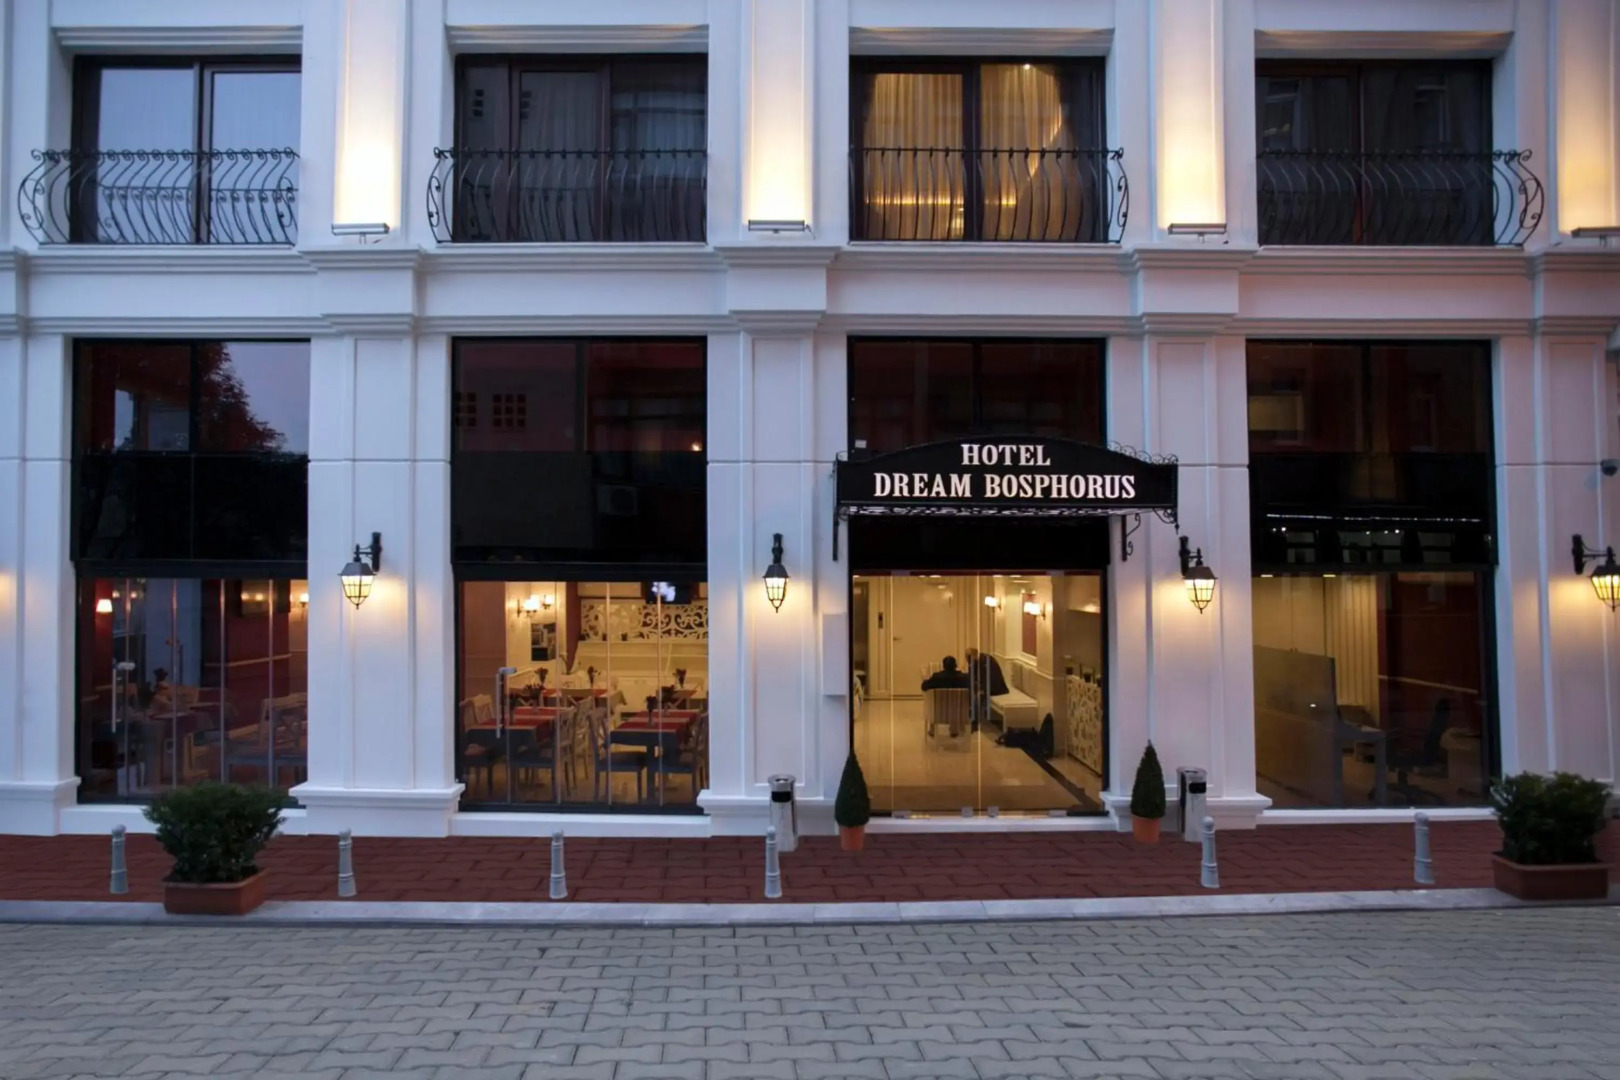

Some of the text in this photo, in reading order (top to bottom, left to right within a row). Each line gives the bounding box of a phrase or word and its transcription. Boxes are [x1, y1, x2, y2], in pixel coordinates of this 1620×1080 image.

[960, 443, 1051, 467] HOTEL
[873, 472, 1136, 499] DREAM BOSPHORUS
